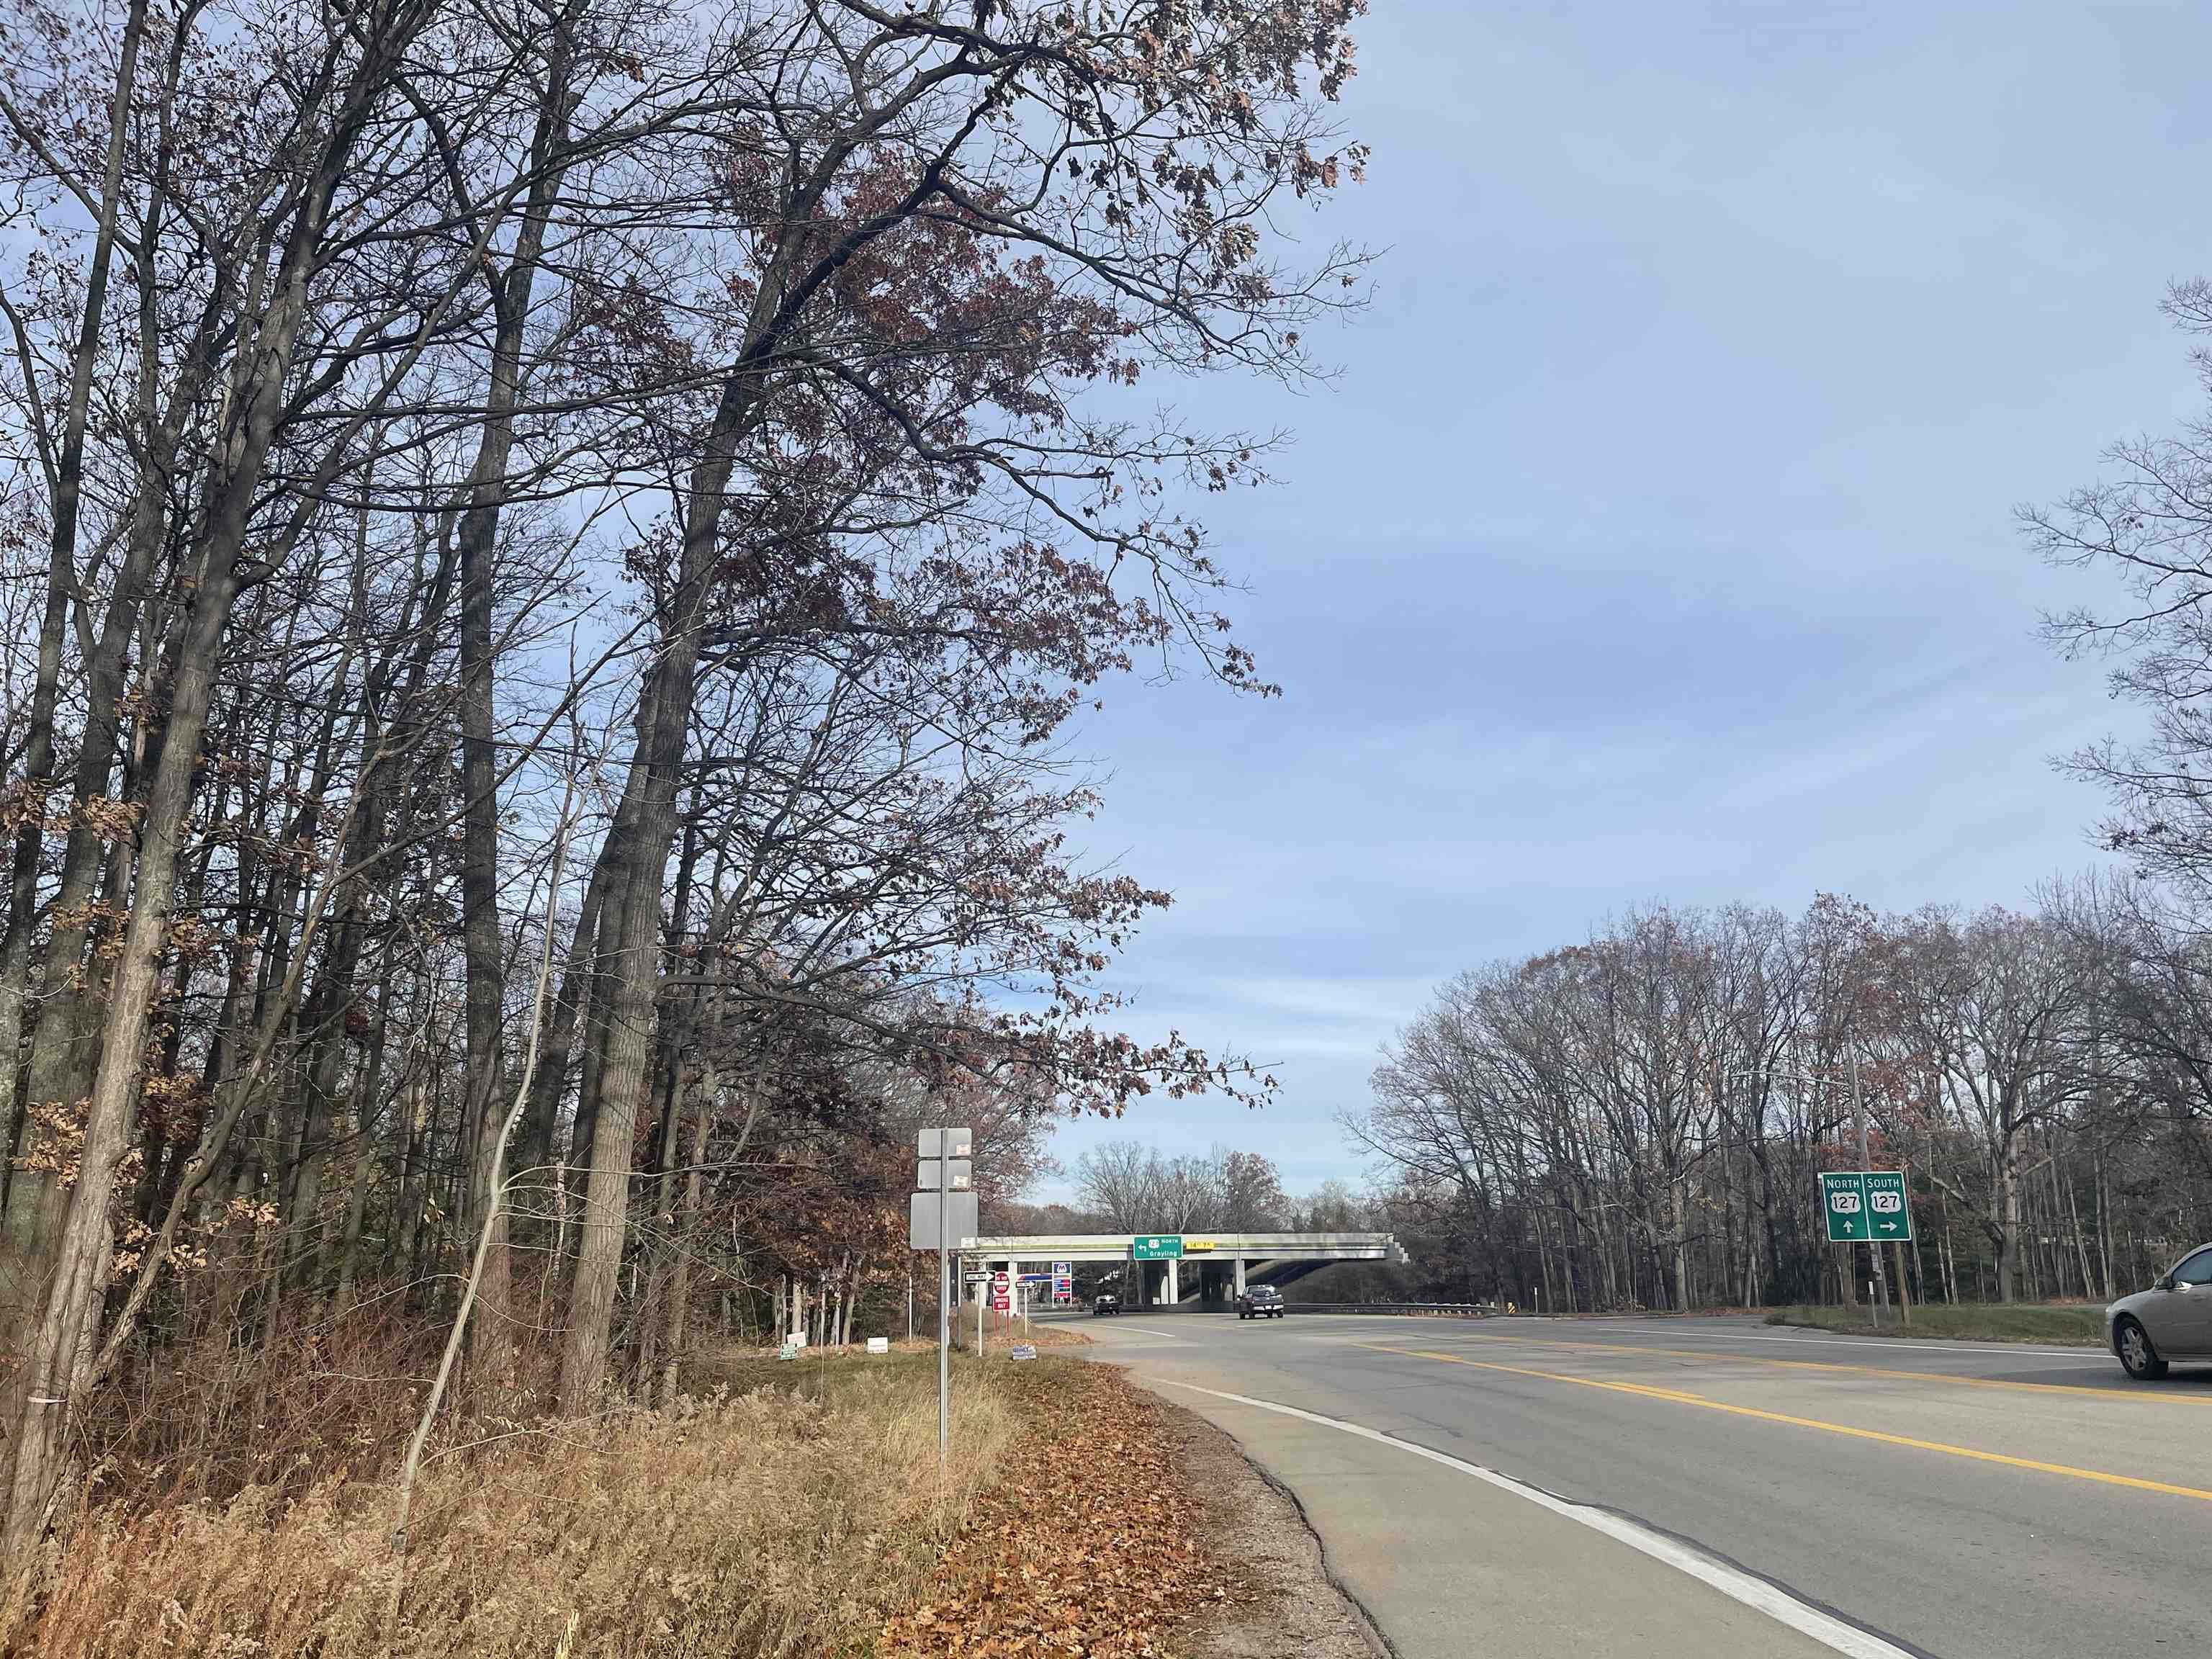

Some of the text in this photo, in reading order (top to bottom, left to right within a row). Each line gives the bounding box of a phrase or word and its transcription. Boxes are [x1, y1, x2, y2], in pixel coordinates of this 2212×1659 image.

[1827, 1179, 1860, 1189] NORTH
[1867, 1179, 1899, 1187] SOUTH
[1833, 1196, 1857, 1208] 127
[1874, 1195, 1898, 1208] 127
